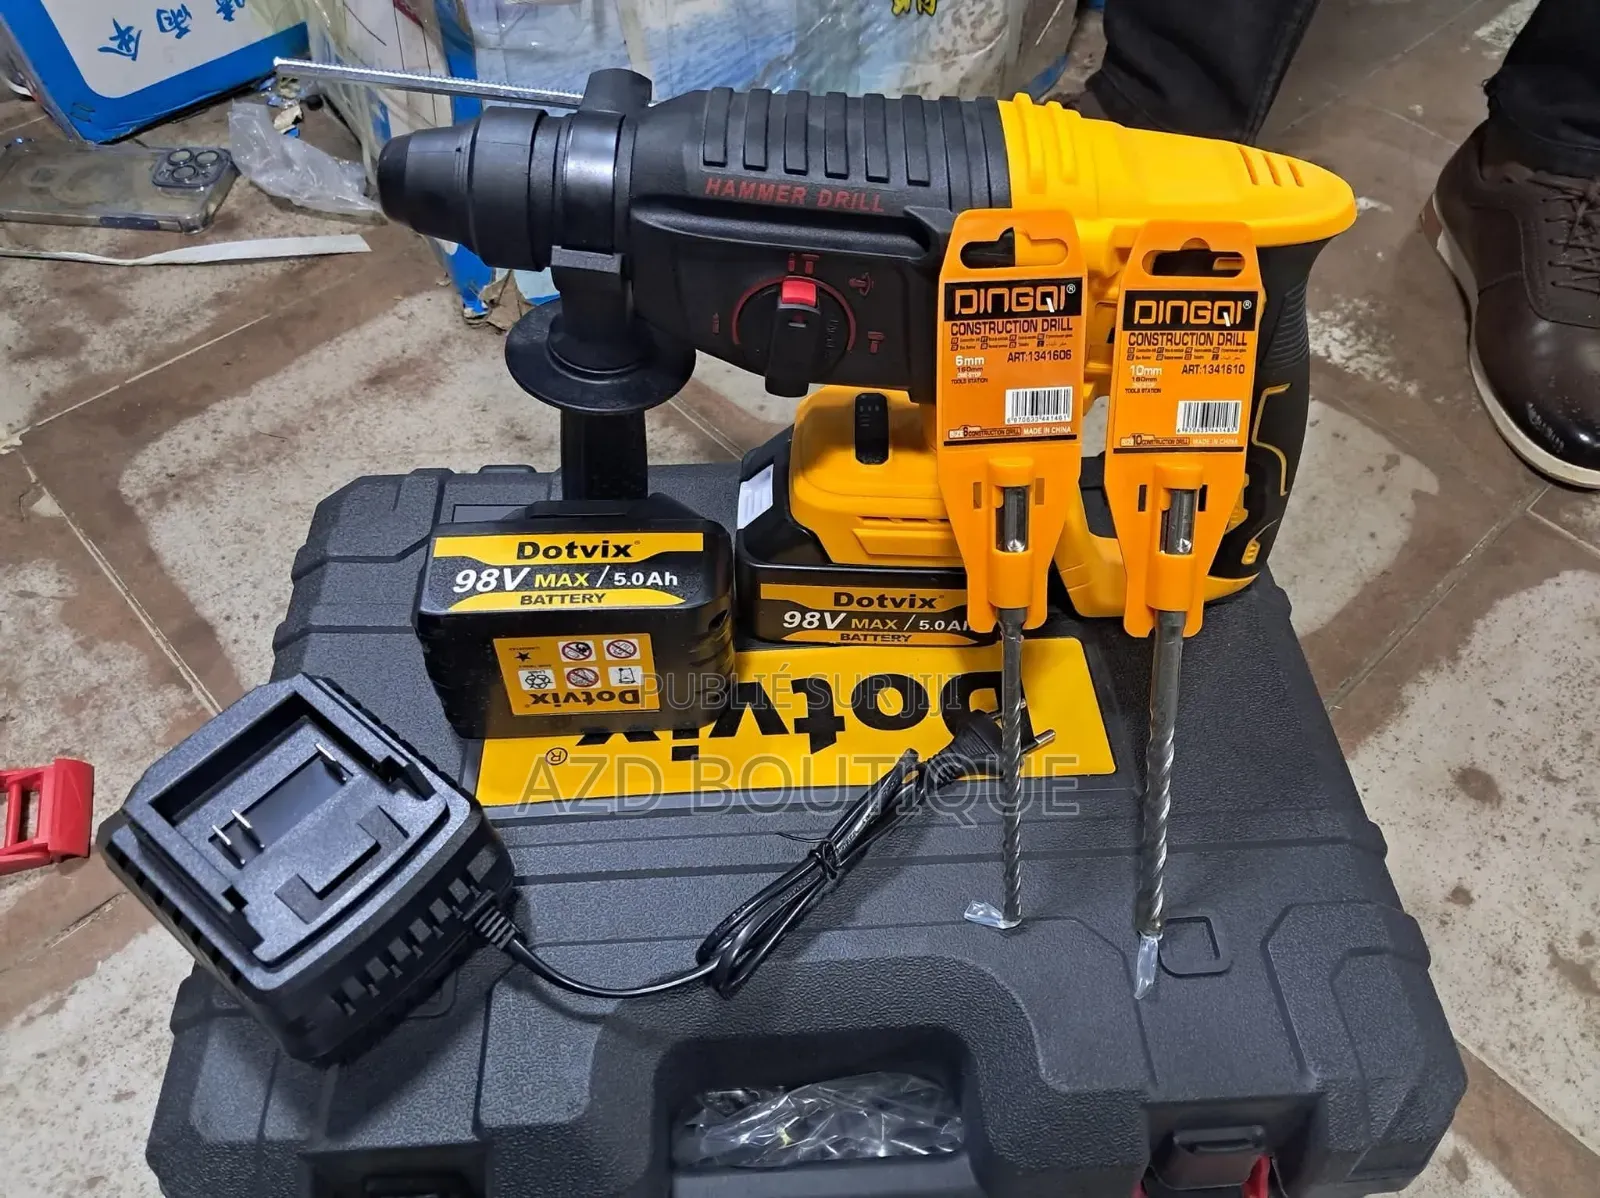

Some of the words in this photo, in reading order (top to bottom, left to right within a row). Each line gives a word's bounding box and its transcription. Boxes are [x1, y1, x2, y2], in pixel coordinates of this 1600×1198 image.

[705, 177, 808, 204] HAMMER
[817, 188, 885, 213] DRILL
[950, 319, 1038, 337] CONSTRUCTION
[1041, 317, 1073, 333] DRILL
[1128, 332, 1214, 347] CONSTRUCTION
[1217, 332, 1247, 347] DRILL
[955, 354, 985, 367] 6mm
[1006, 349, 1072, 363] ART:1341606
[1129, 364, 1163, 376] 10mm
[1181, 364, 1245, 375] ART:1341610
[1051, 426, 1072, 434] CHINA
[452, 566, 532, 593] 98V
[534, 571, 590, 588] MAX
[614, 570, 679, 587] 5.0Ah
[520, 592, 606, 606] BATTERY
[782, 610, 847, 630] 98V
[851, 617, 898, 630] MAX
[840, 632, 913, 643] BATTERY
